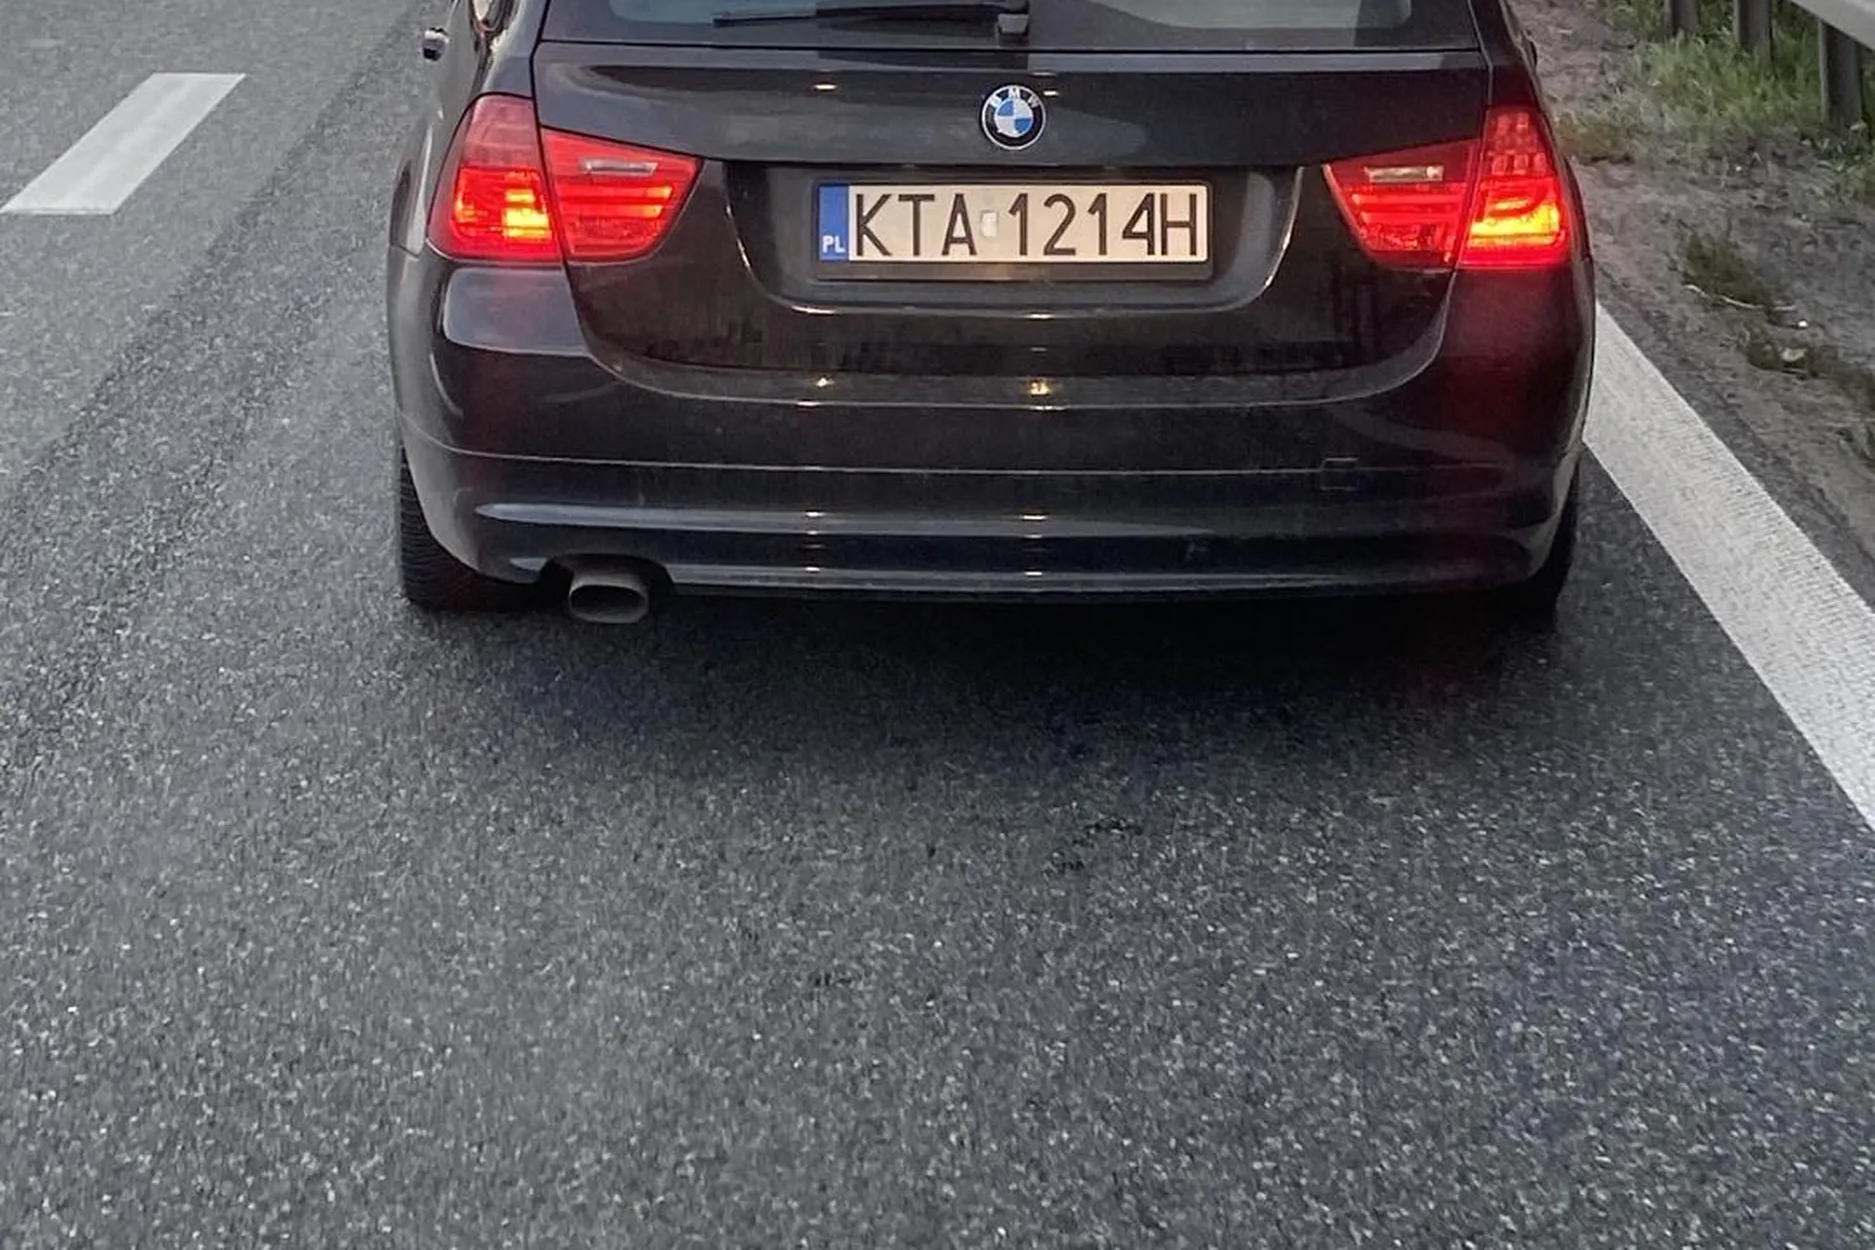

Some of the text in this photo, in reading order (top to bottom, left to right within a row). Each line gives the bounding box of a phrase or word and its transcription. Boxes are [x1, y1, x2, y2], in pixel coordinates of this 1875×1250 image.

[856, 193, 1199, 256] KTA 1214H
[822, 237, 846, 253] PL
